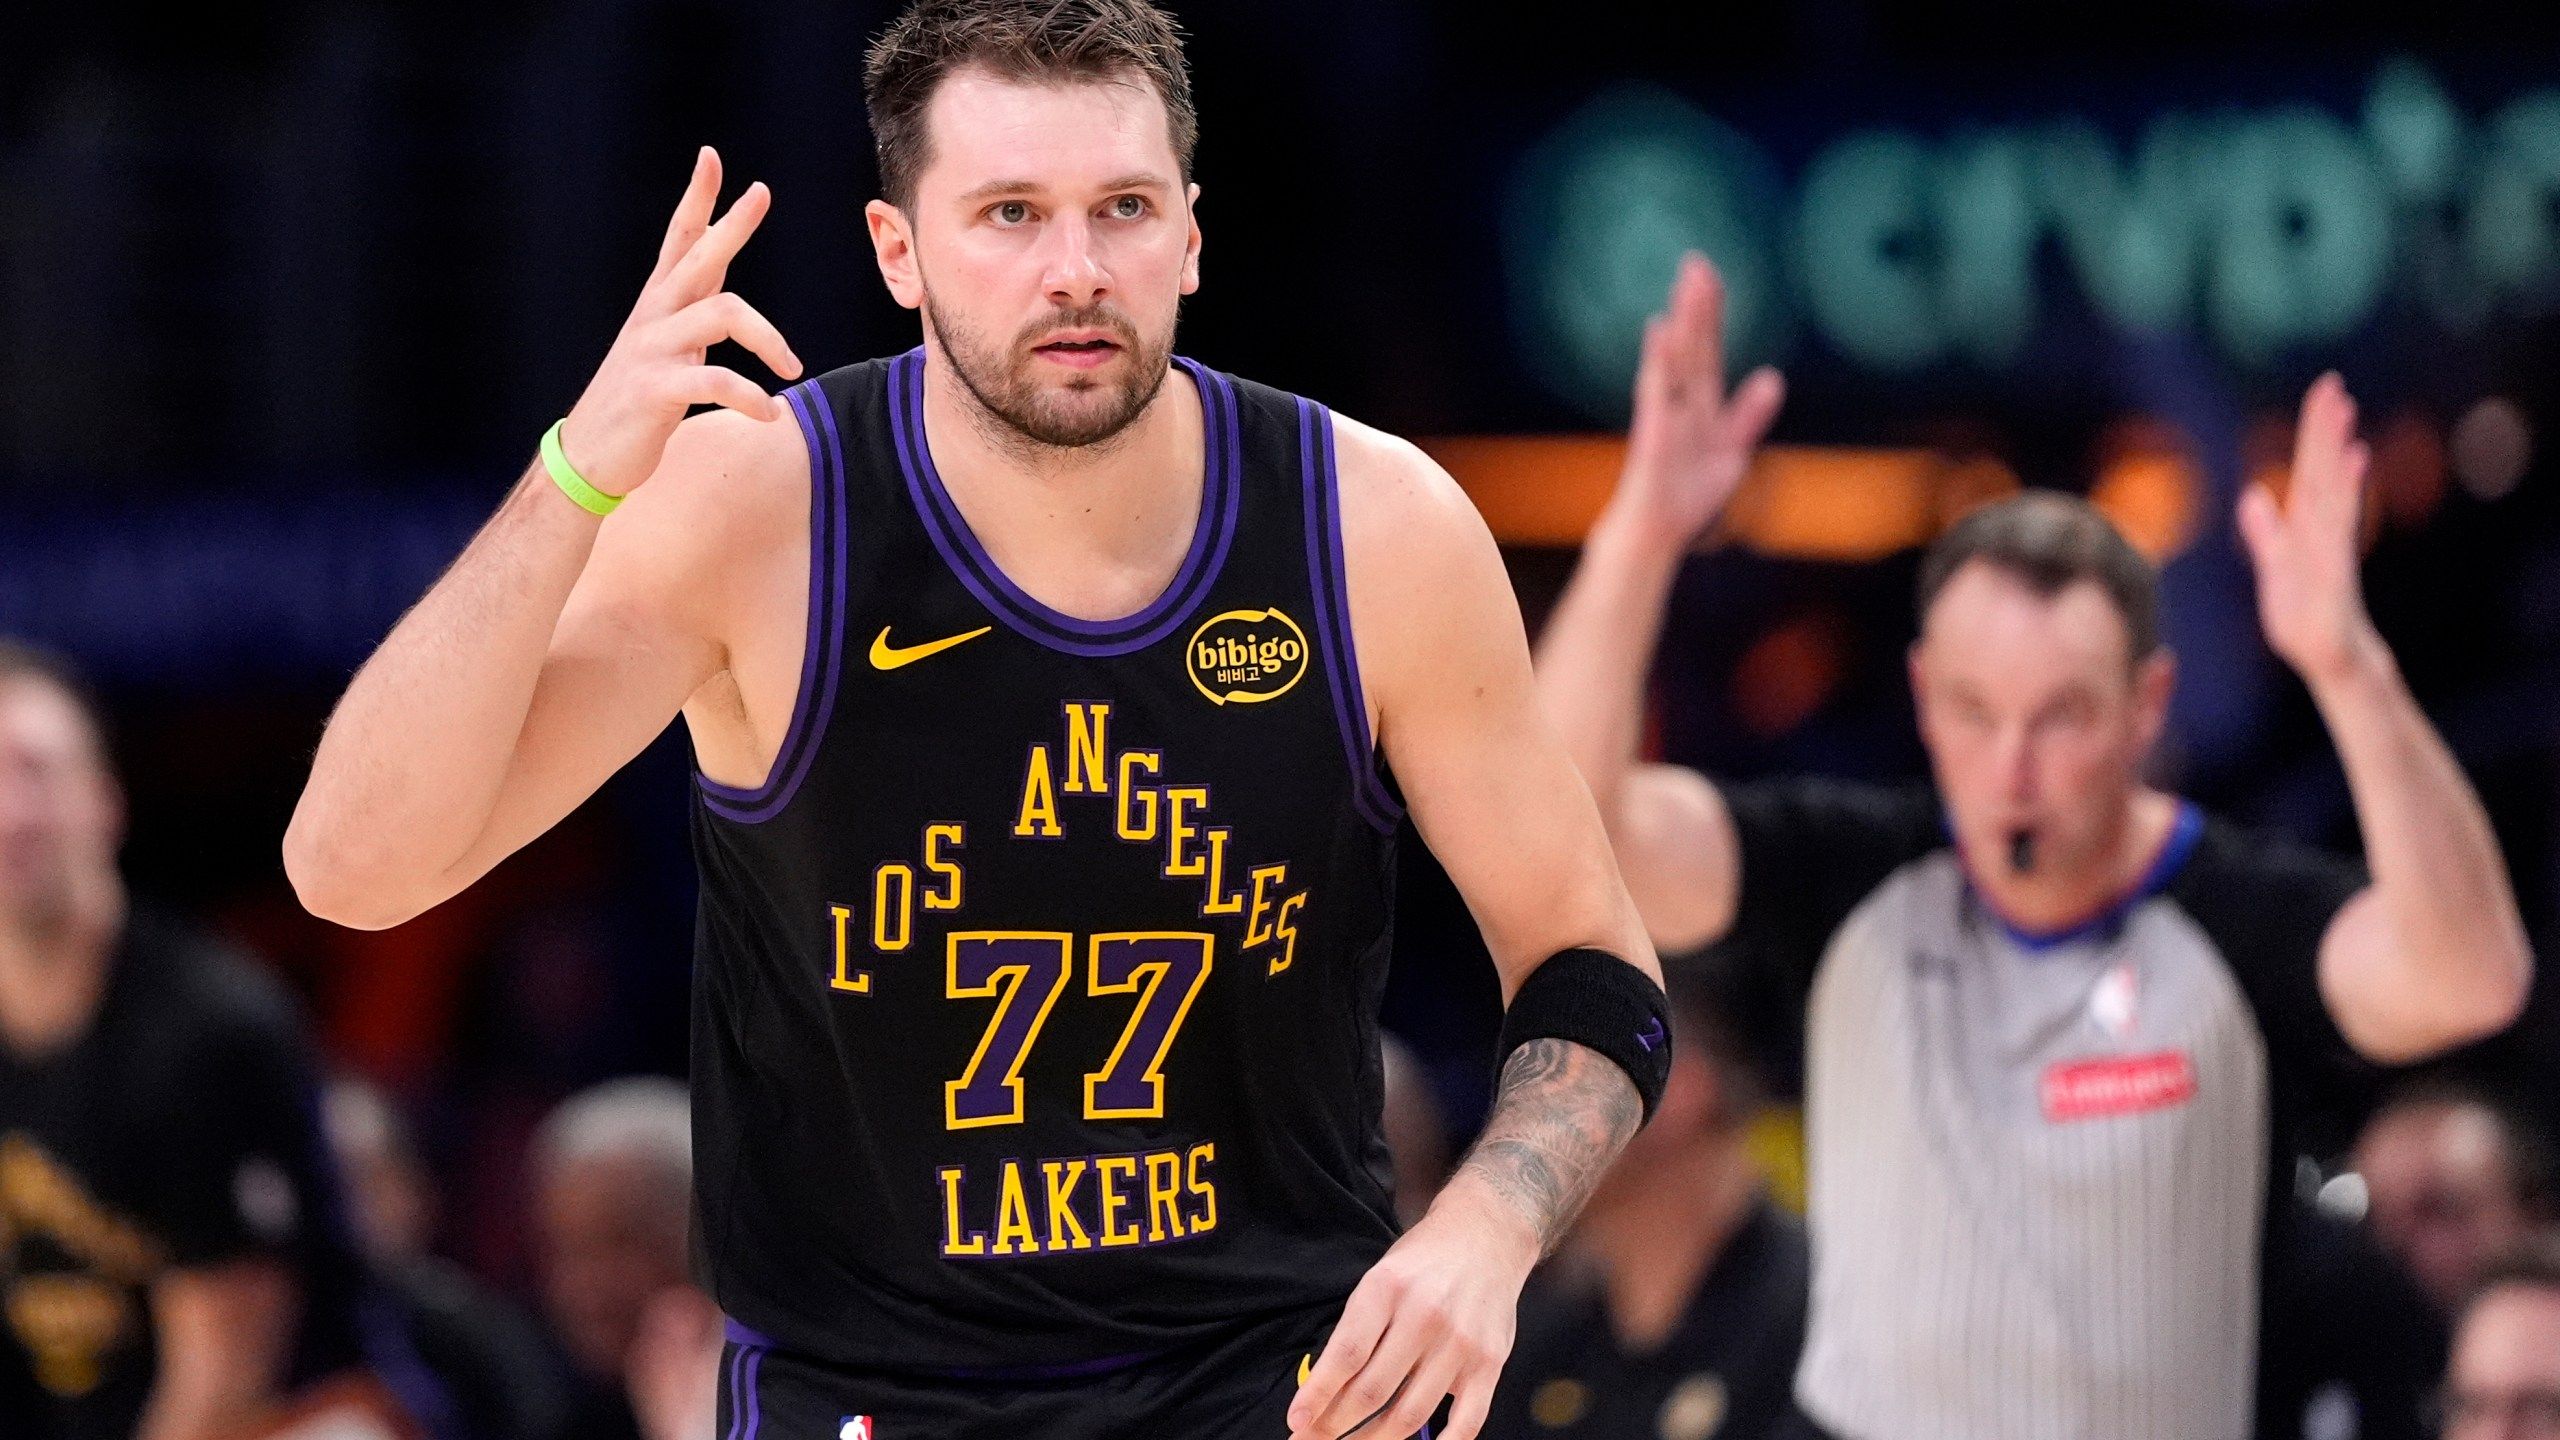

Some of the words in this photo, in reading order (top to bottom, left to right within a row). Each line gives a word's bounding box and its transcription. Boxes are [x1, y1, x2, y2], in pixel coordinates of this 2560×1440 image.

[1197, 633, 1300, 674] bibigo
[1217, 666, 1261, 685] 비비고
[828, 819, 966, 996] LOS
[1010, 700, 1308, 980] ANGELES
[944, 931, 1216, 1131] 77
[938, 1142, 1219, 1260] LAKERS
